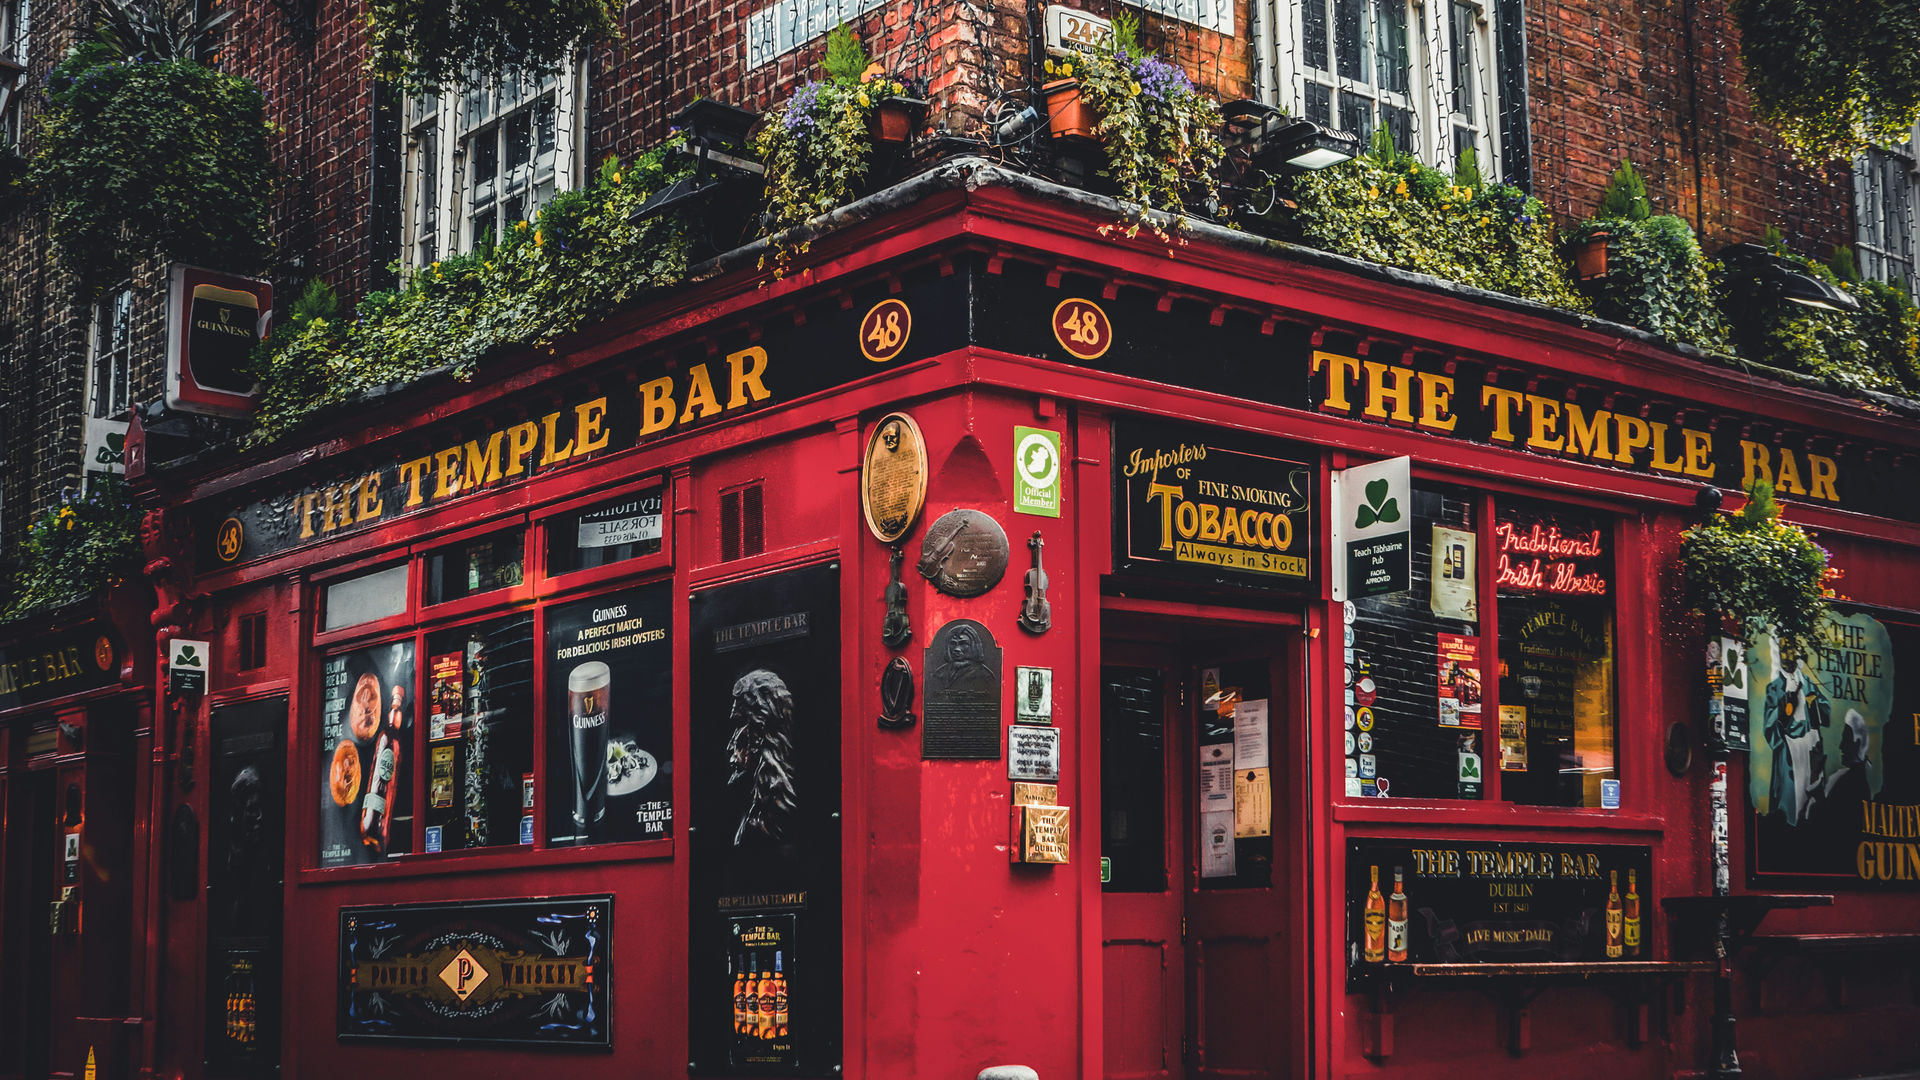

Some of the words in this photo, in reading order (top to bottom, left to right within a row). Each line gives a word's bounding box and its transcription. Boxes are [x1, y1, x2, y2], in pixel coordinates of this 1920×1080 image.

[799, 4, 850, 36] TEMPLE
[197, 319, 251, 338] GUINNESS
[868, 311, 901, 352] 48
[1063, 307, 1099, 345] 48
[1313, 350, 1458, 430] THE
[1481, 386, 1717, 479] TEMPLE
[1740, 440, 1841, 502] BAR
[294, 472, 383, 539] THE
[401, 397, 610, 507] TEMPLE
[639, 346, 771, 436] BAR
[1123, 443, 1207, 482] Importers
[1176, 467, 1191, 480] OF
[1023, 496, 1054, 507] Member
[1025, 487, 1051, 498] Official
[1199, 480, 1229, 499] FINE
[1231, 485, 1291, 508] SMOKING
[1147, 481, 1293, 551] TOBACCO
[221, 527, 237, 555] 48
[1496, 523, 1602, 557] Traditional
[1178, 542, 1234, 564] Always
[1242, 551, 1255, 568] in
[1262, 553, 1304, 574] Stock
[1354, 547, 1371, 557] Teach
[1372, 555, 1384, 565] Pub
[1496, 554, 1543, 587] Irish
[593, 604, 627, 623] GUINNESS
[578, 630, 584, 641] A
[584, 624, 616, 641] PERFECT
[617, 618, 642, 633] MATCH
[716, 629, 735, 643] THE
[738, 620, 781, 639] TEMPLE
[784, 613, 806, 629] BAR
[1520, 611, 1567, 640] TEMPLE
[1830, 620, 1866, 650] THE
[557, 648, 571, 660] FOR
[572, 640, 610, 658] DELICIOUS
[611, 635, 631, 650] IRISH
[632, 629, 665, 646] OYSTERS
[43, 648, 83, 682] BAR
[1816, 648, 1882, 679] TEMPLE
[1832, 675, 1868, 704] BAR
[573, 712, 605, 729] GUINNESS
[1362, 759, 1372, 767] tax
[1362, 766, 1374, 774] free
[636, 808, 672, 824] TEMPLE
[646, 800, 661, 810] THE
[645, 821, 663, 833] BAR
[1035, 826, 1063, 834] TEMPLE
[1034, 845, 1062, 853] DUBLIN
[1412, 849, 1460, 877] THE
[1466, 850, 1553, 878] TEMPLE
[1560, 852, 1601, 878] BAR
[770, 891, 805, 904] TEMPLE
[1489, 883, 1534, 897] DUBLIN
[1493, 902, 1508, 913] EST
[741, 932, 765, 942] TEMPLE
[766, 931, 781, 940] BAR
[754, 925, 766, 933] THE
[1467, 928, 1491, 945] LIVE
[1493, 930, 1523, 943] MUSIC
[1525, 930, 1554, 942] DAILY
[371, 965, 428, 987] POWERS
[502, 963, 577, 985] WHISKEY
[457, 958, 473, 990] P
